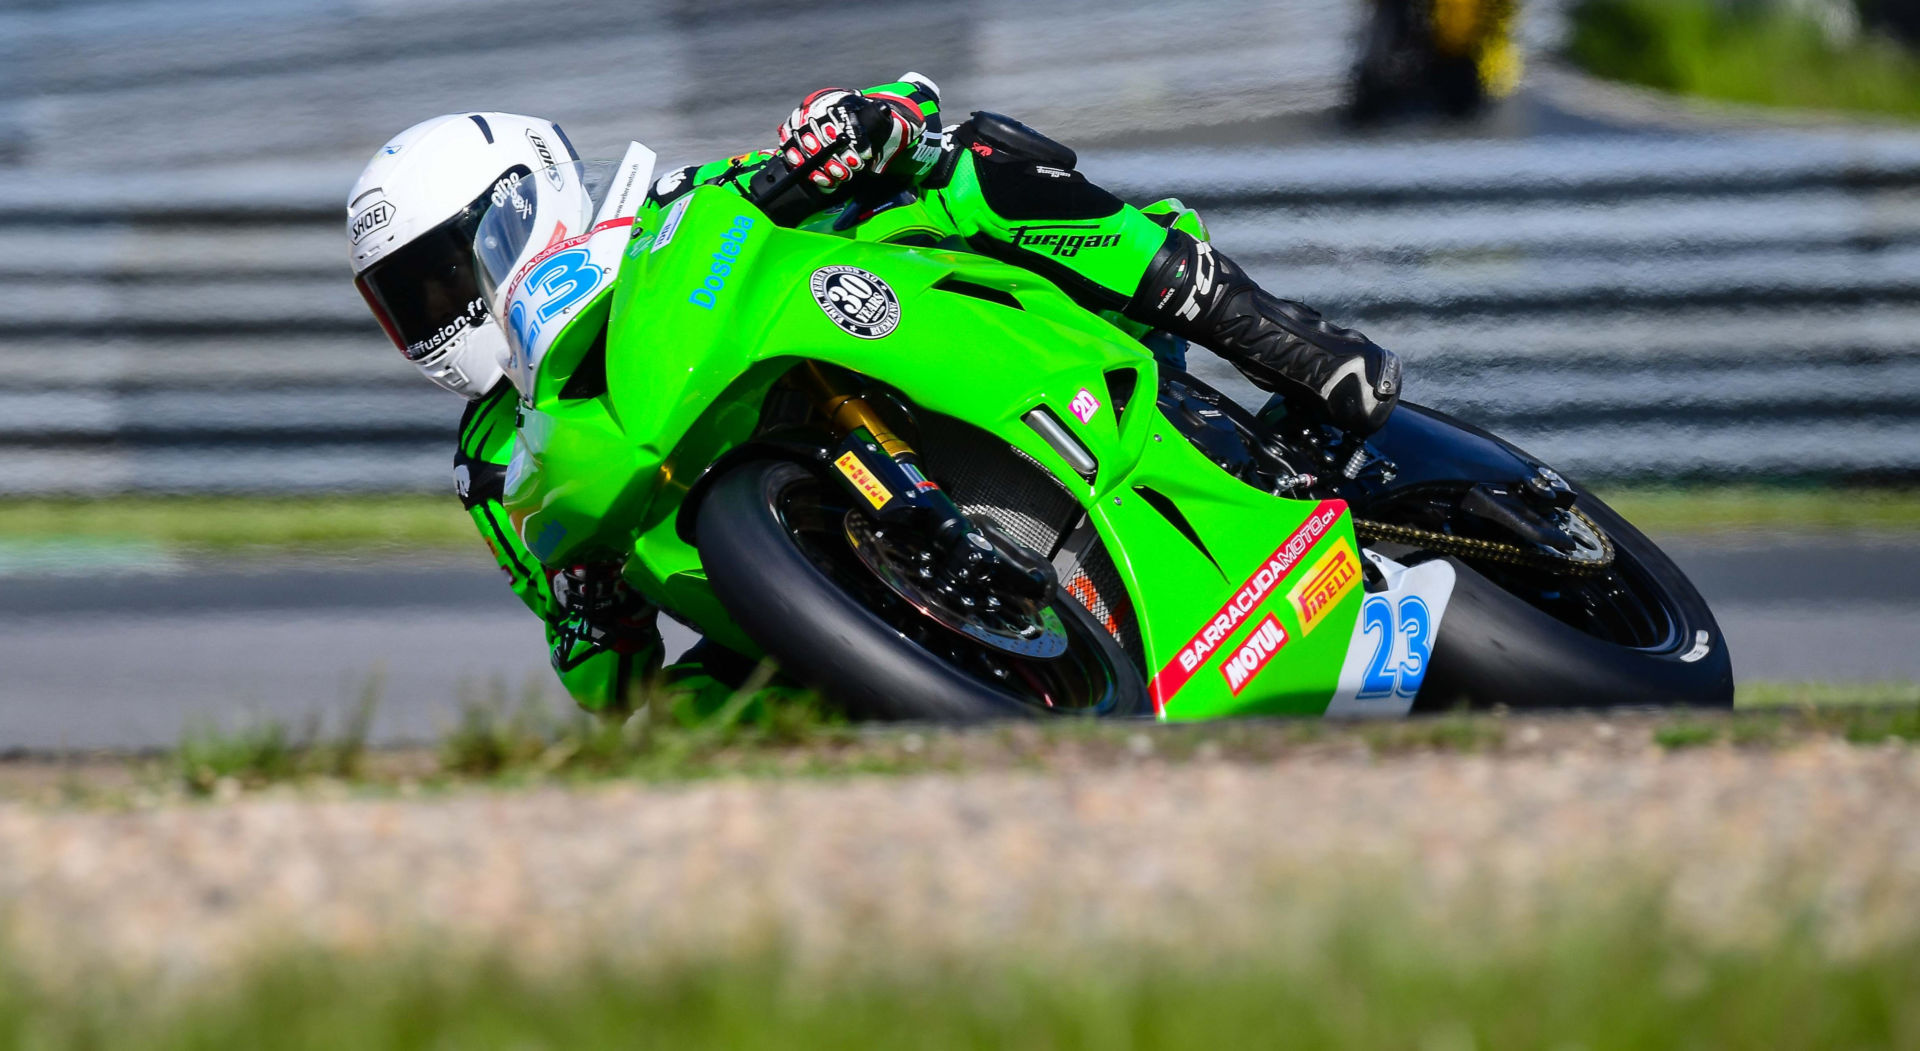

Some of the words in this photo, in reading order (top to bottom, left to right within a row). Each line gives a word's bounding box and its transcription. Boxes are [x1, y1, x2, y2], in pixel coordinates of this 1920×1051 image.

[352, 205, 387, 241] SHOEI
[688, 215, 755, 311] Dosteba
[828, 274, 873, 315] 30
[508, 248, 604, 359] 23
[855, 291, 885, 323] YEARS
[1071, 390, 1099, 424] 20
[1179, 508, 1336, 673] BARRACUDAMOTO.CH
[1297, 550, 1357, 624] PIRELLI
[1224, 618, 1285, 691] MOTUL
[1355, 595, 1431, 700] 23
